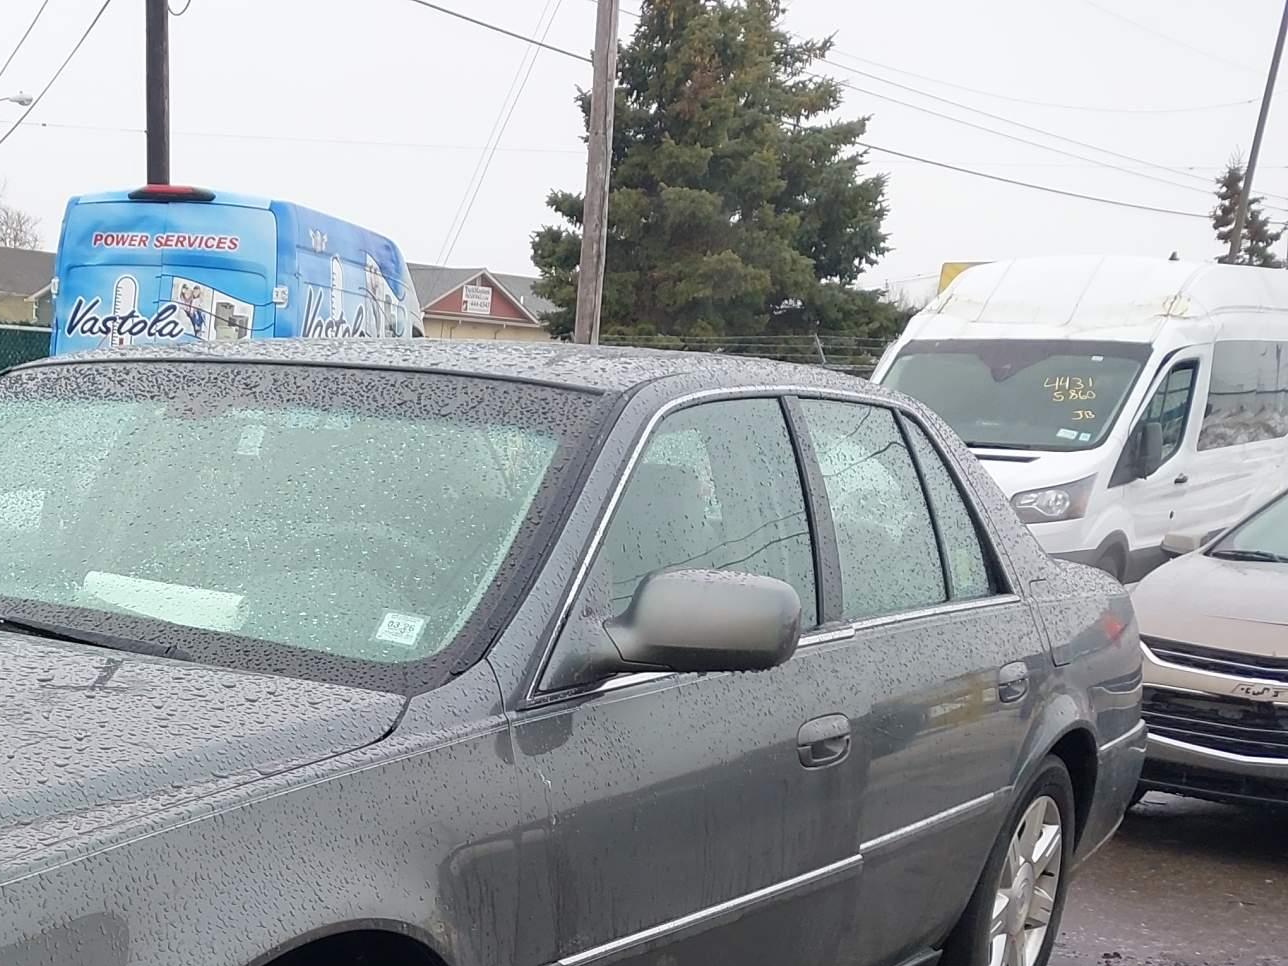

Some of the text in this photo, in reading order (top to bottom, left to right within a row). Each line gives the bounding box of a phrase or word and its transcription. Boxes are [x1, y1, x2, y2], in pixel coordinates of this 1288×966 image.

[93, 233, 239, 250] POWER SERVICES
[66, 299, 184, 338] Vastola
